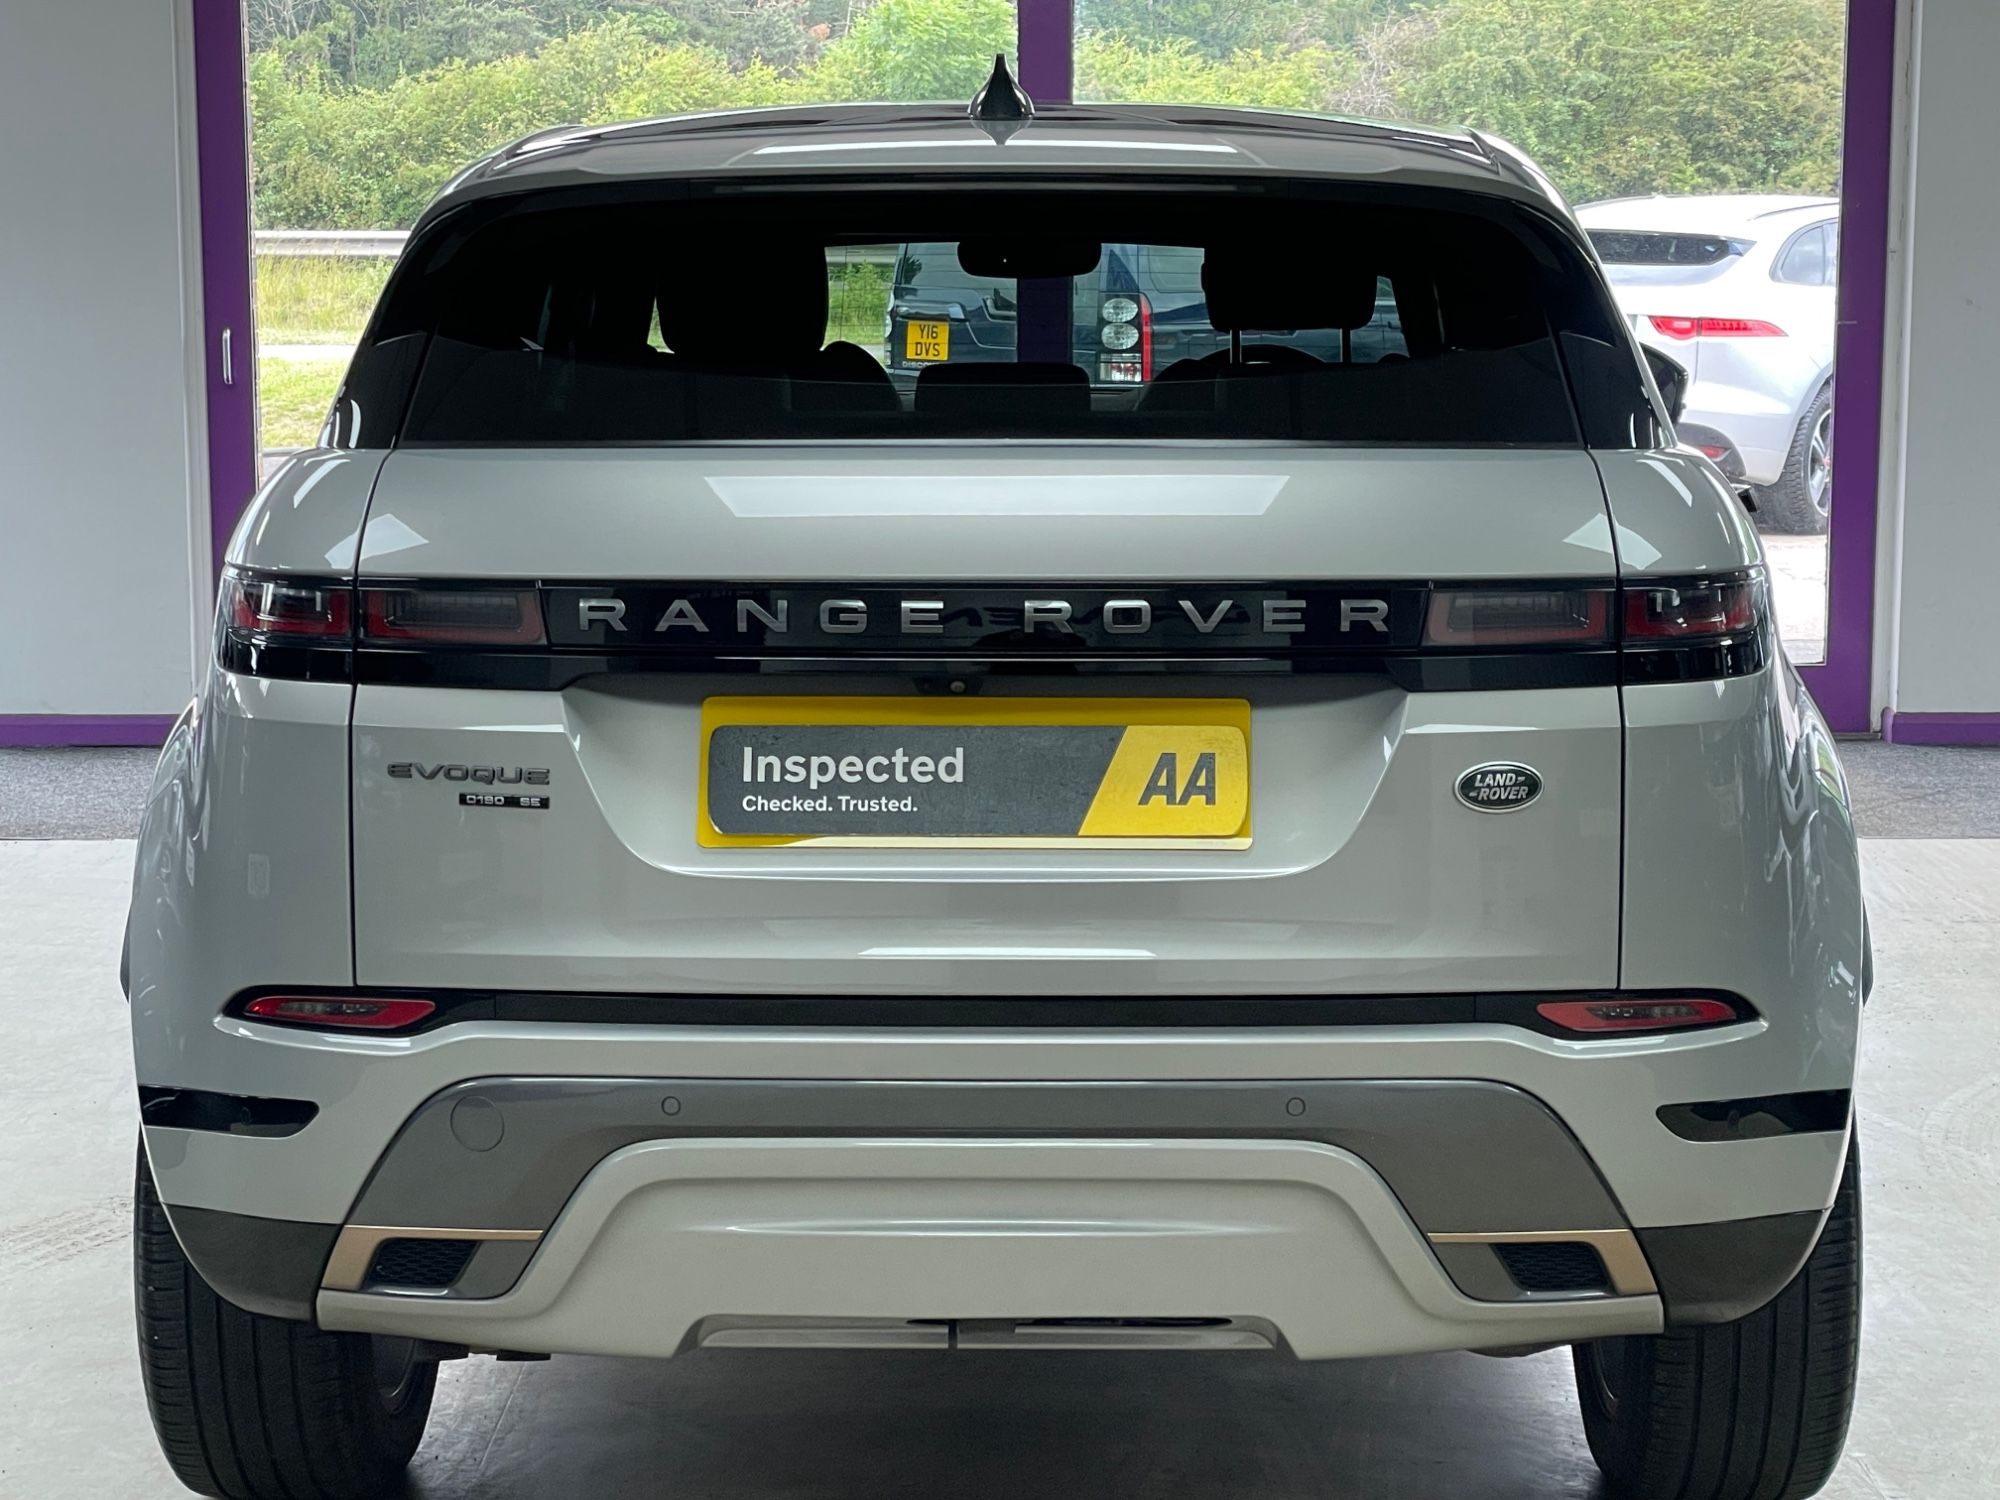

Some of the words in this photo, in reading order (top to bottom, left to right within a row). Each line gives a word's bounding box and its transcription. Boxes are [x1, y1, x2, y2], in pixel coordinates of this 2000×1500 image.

[919, 324, 938, 339] Y16
[915, 341, 940, 357] DVS
[578, 598, 945, 635] RANGE
[1023, 598, 1390, 635] ROVER
[386, 762, 550, 785] EVOQUE
[742, 746, 965, 790] Inspected
[1138, 752, 1217, 807] AA
[1474, 773, 1516, 787] LAND
[519, 796, 541, 807] SE
[1478, 786, 1528, 800] ROVER
[742, 795, 834, 813] Checked.
[837, 795, 919, 813] Trusted.
